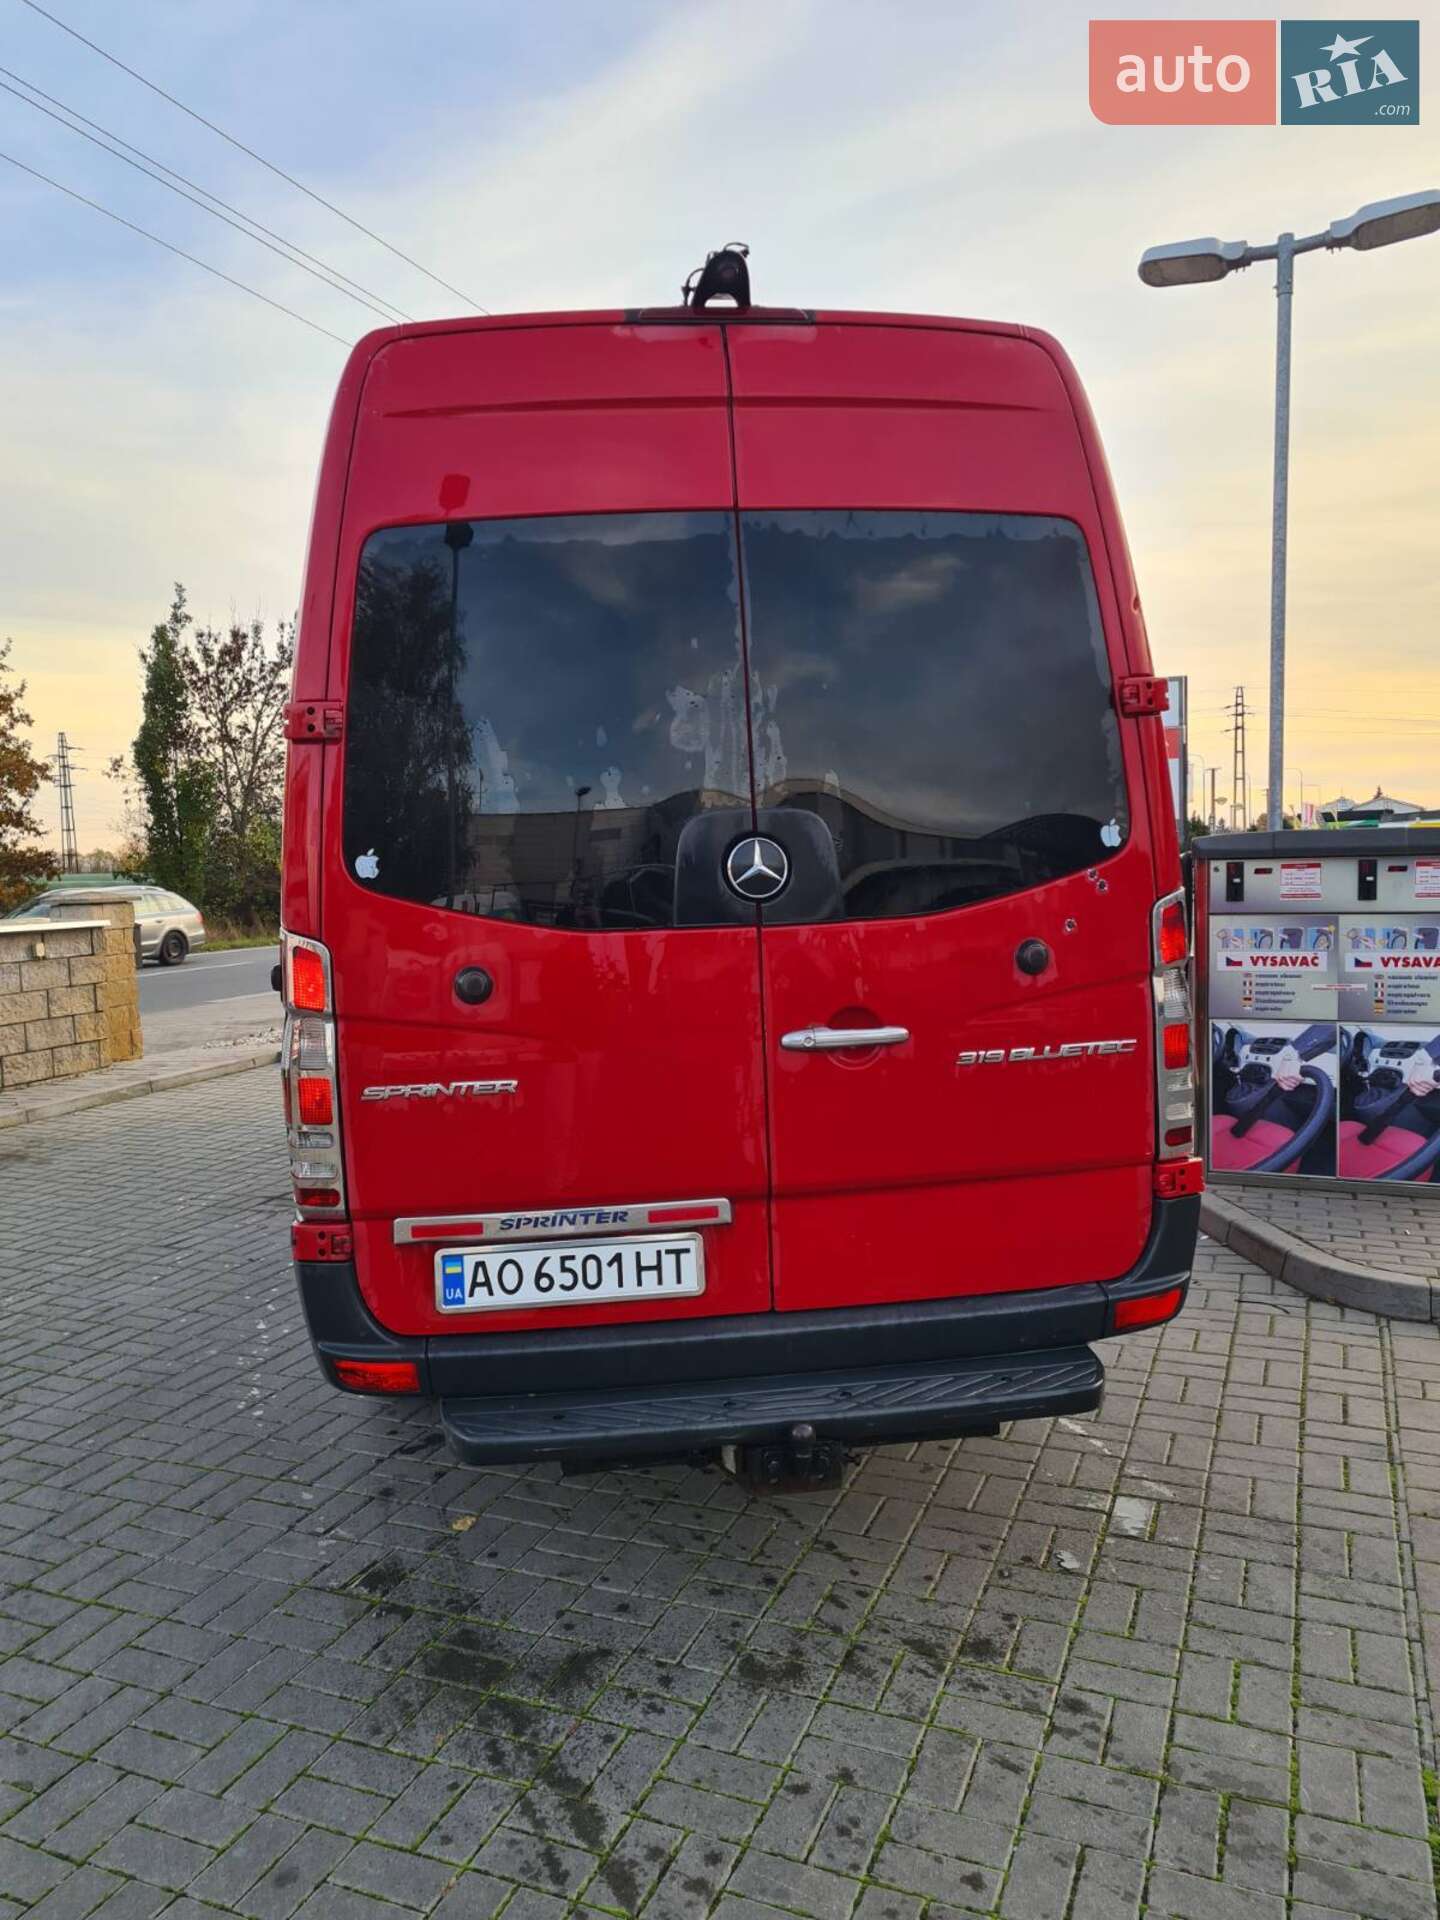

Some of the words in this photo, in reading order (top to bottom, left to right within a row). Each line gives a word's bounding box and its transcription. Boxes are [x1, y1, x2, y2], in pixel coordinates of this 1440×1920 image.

[1250, 952, 1320, 967] VYSAVAČ
[956, 1049, 1005, 1065] 319
[1008, 1039, 1137, 1062] BLUETEC
[361, 1080, 518, 1101] SPRINTER
[499, 1210, 629, 1231] SPRINTER
[445, 1288, 463, 1300] UA
